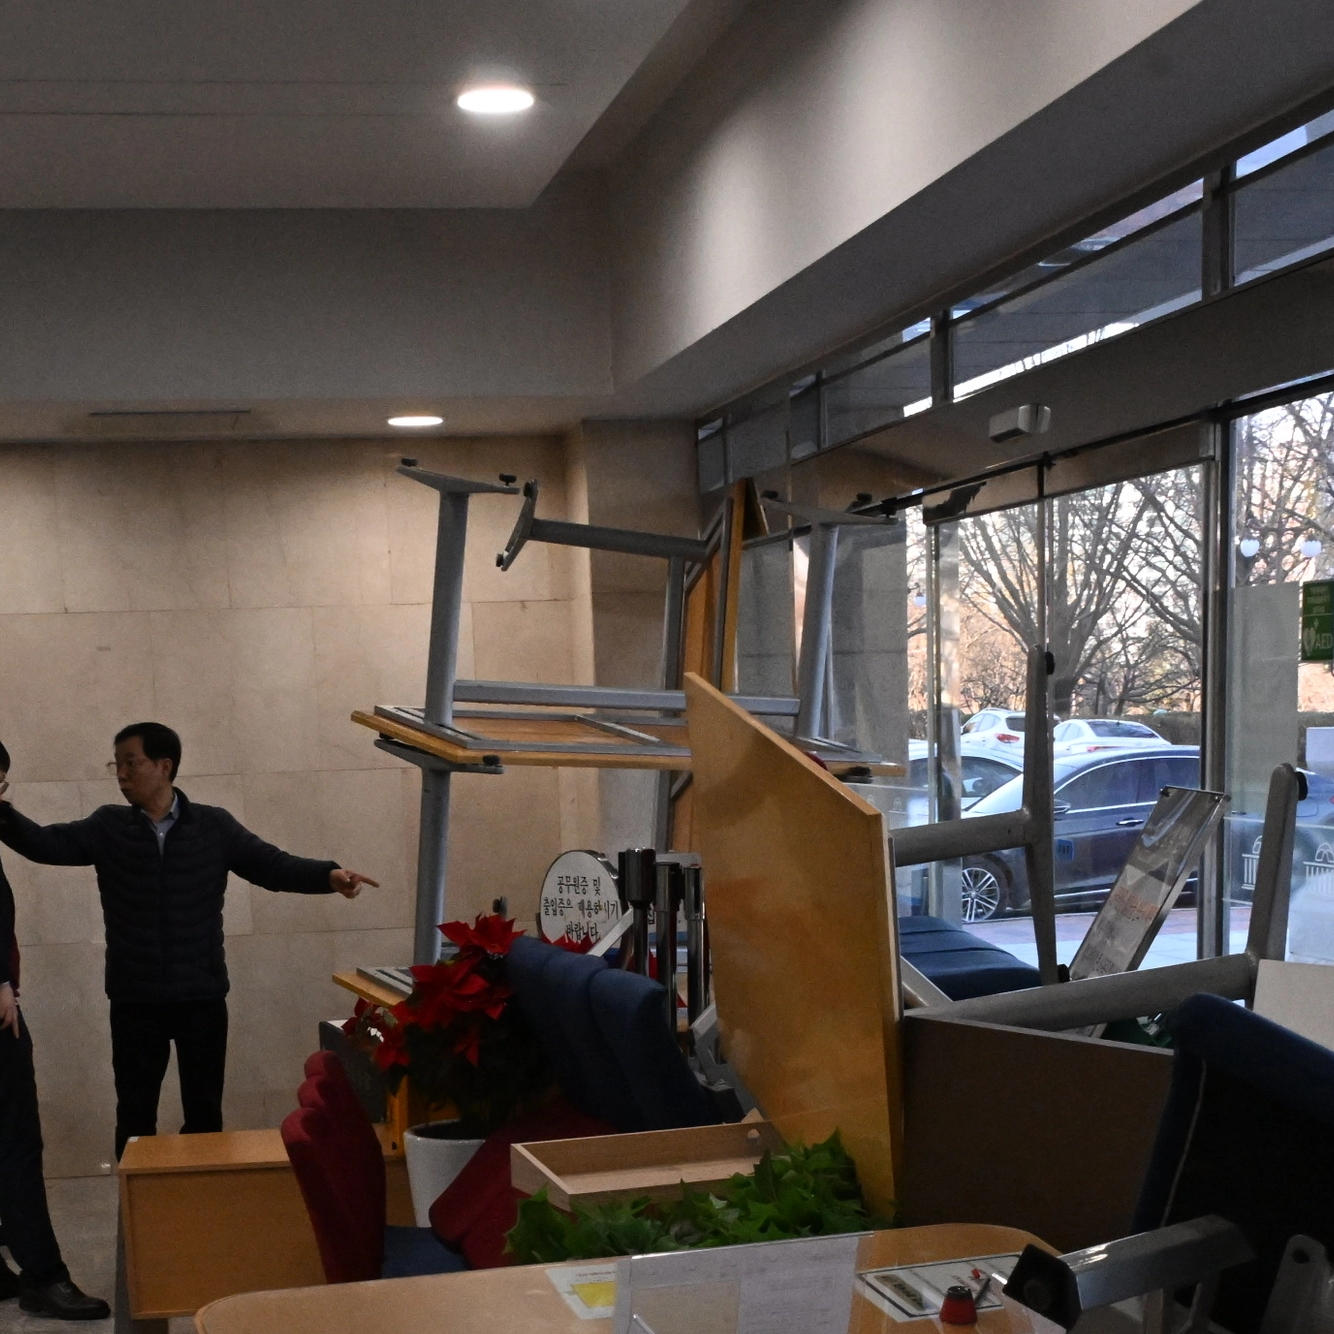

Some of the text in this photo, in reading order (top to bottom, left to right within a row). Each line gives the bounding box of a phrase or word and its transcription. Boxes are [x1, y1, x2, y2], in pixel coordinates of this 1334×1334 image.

[1315, 632, 1333, 650] AED
[557, 875, 601, 896] 공무원증 및
